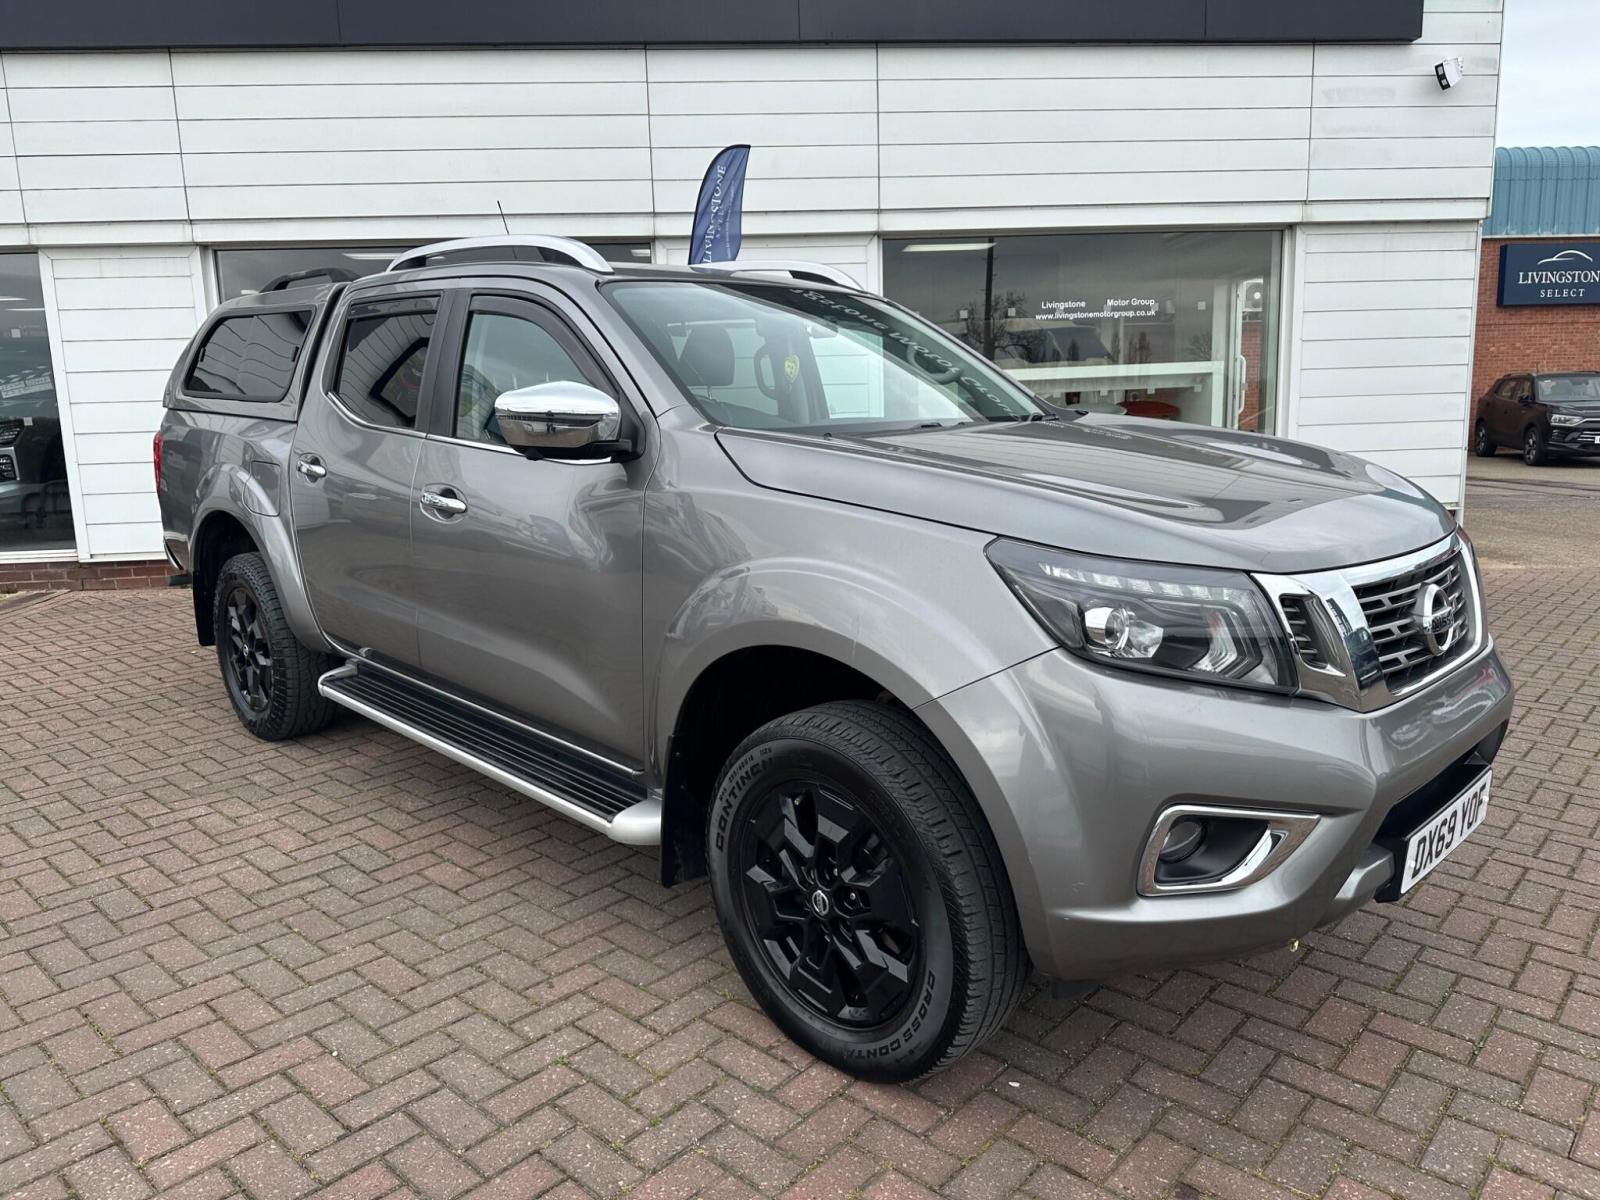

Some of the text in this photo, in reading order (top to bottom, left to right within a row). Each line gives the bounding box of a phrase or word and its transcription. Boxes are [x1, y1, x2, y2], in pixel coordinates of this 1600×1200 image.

[1518, 270, 1600, 284] LIVINGSTON
[1540, 288, 1585, 298] SELECT
[1041, 297, 1155, 310] Livingstone Motor Group
[1035, 309, 1156, 320] www.livingstonemotorgroup.co.uk
[1411, 782, 1487, 880] DX69 YOF
